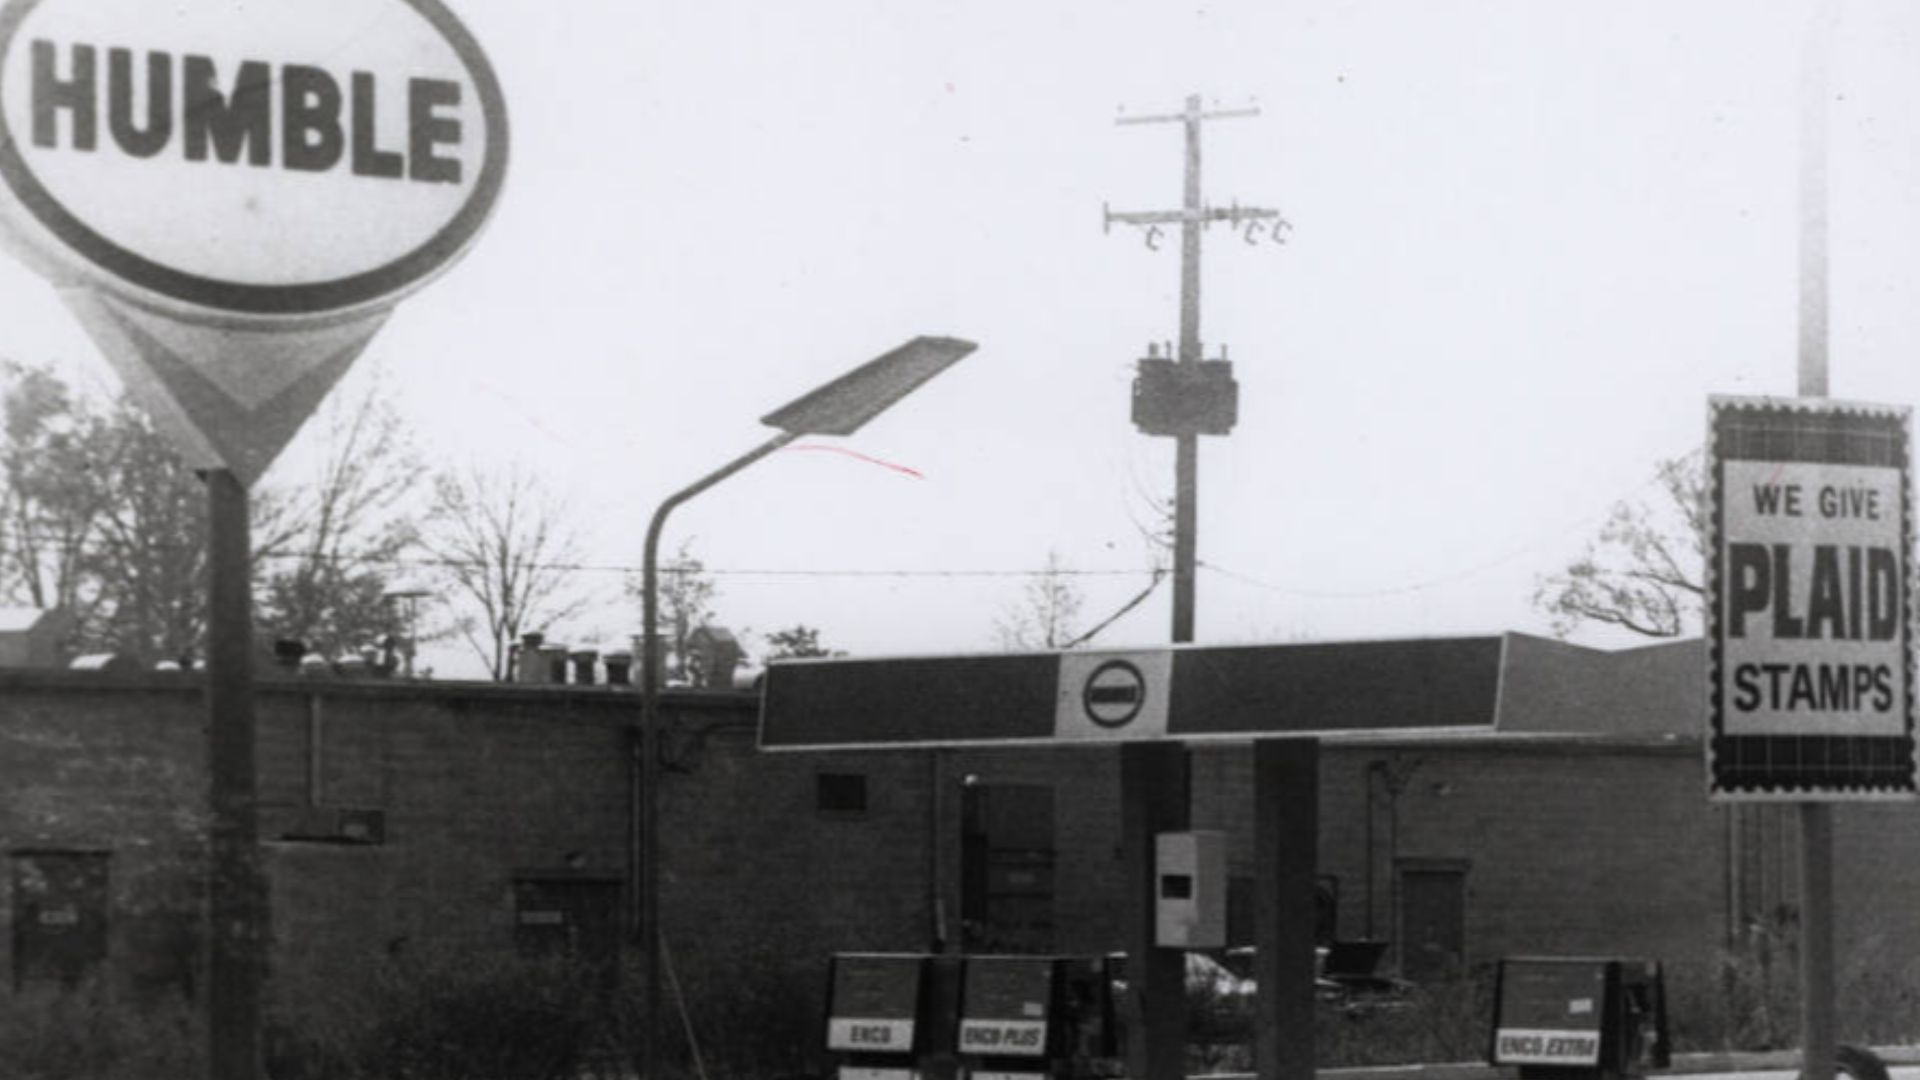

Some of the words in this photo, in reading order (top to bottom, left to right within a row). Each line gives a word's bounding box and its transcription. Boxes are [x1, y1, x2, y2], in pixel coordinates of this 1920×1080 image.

[31, 39, 463, 184] HUMBLE
[1753, 484, 1803, 517] WE
[1818, 485, 1880, 520] GIVE
[1728, 542, 1898, 642] PLAID
[1733, 662, 1893, 713] STAMPS
